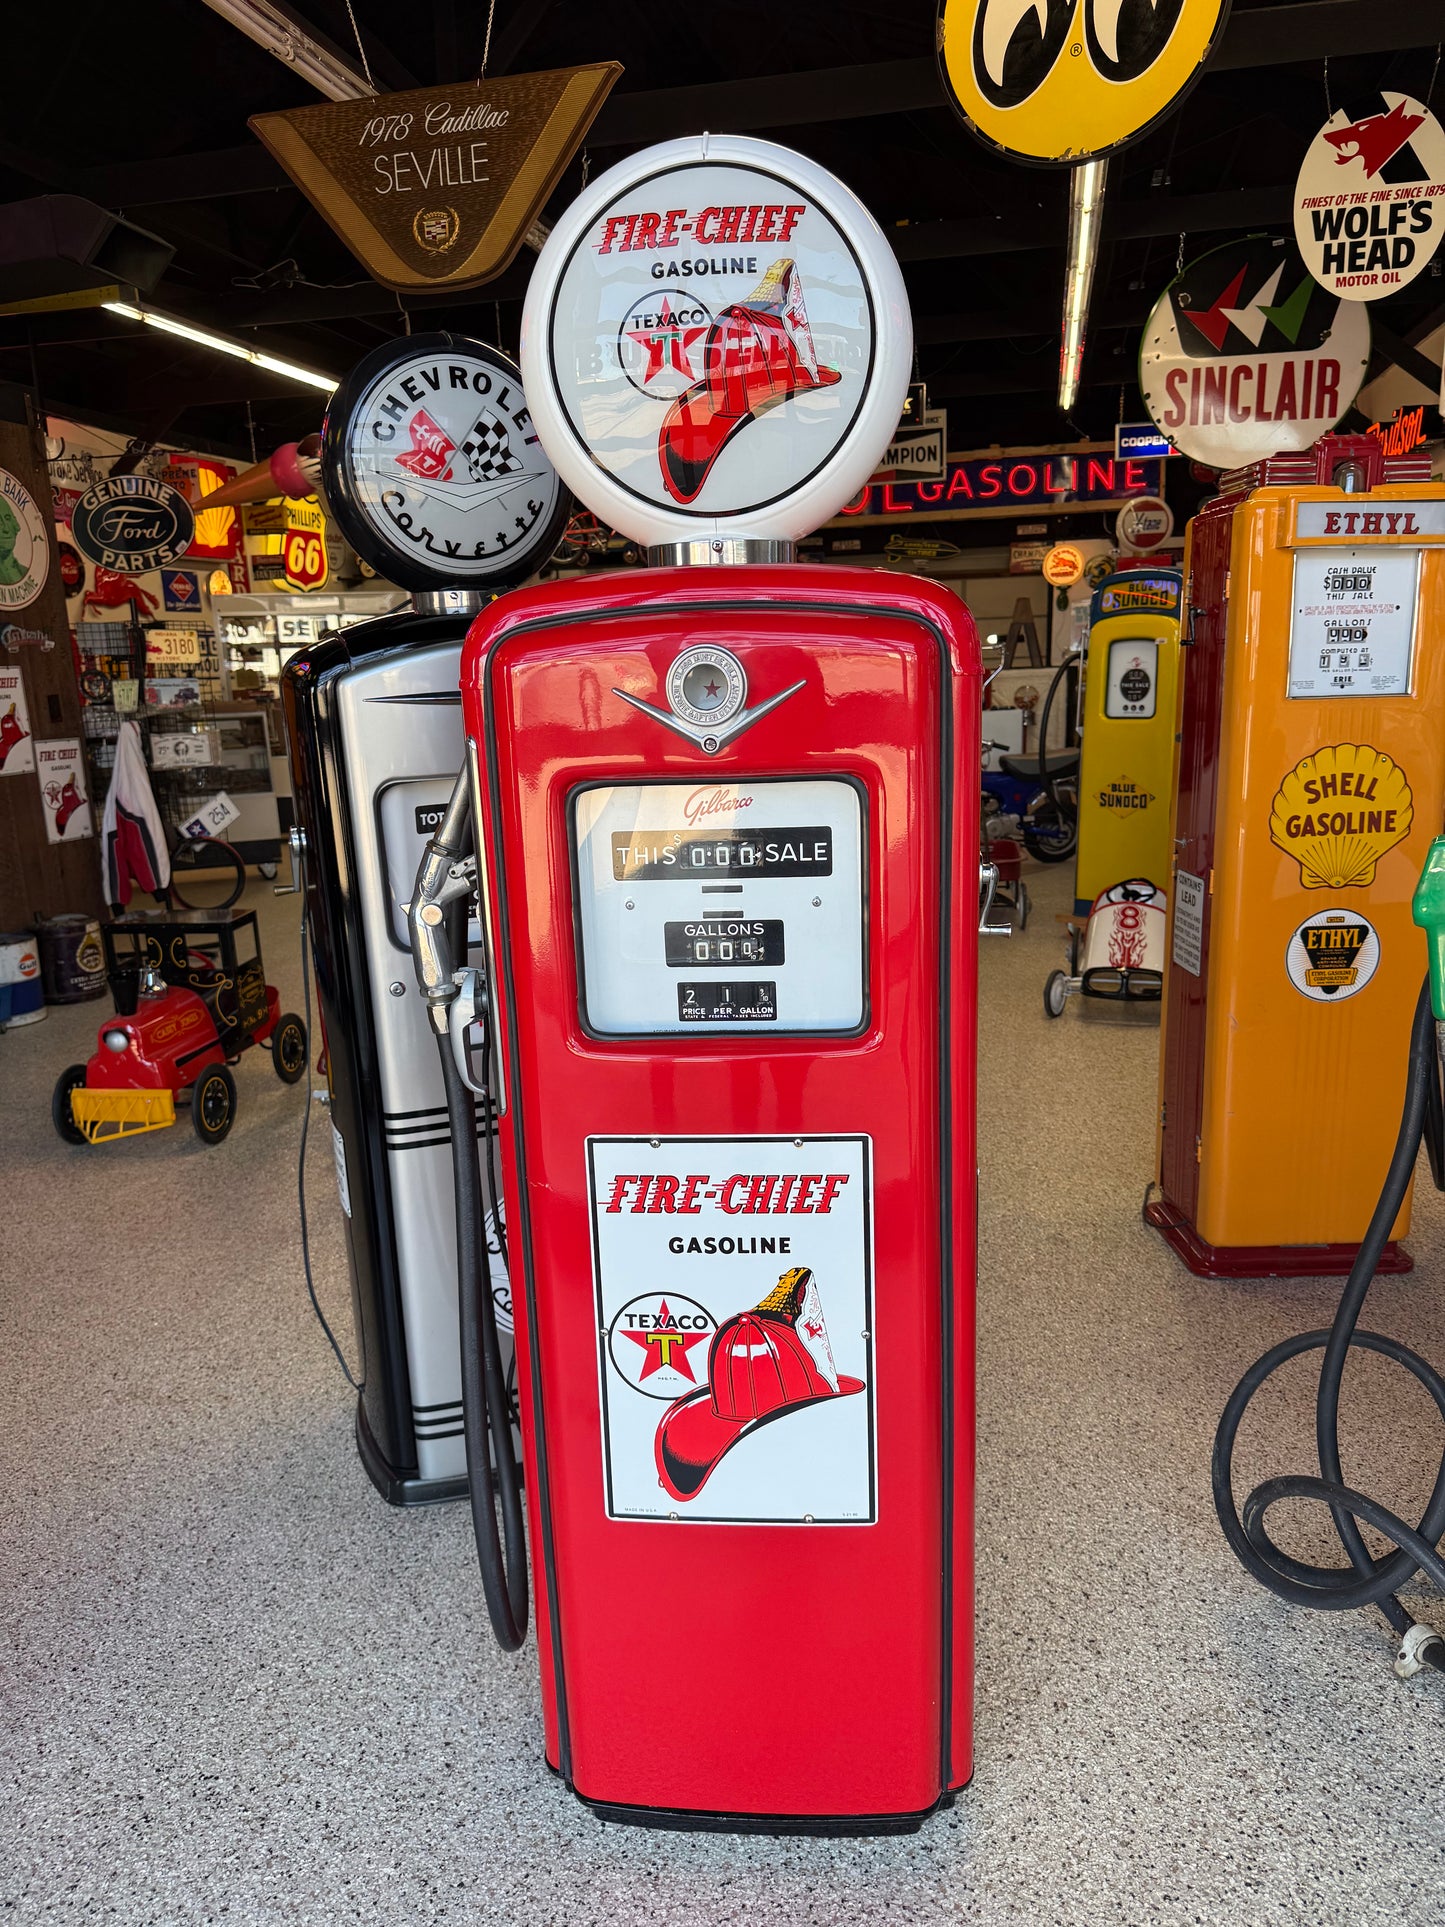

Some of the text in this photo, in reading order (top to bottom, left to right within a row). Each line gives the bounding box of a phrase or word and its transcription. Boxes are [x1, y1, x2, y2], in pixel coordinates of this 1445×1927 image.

[359, 102, 509, 147] 1978 Cadillac
[374, 142, 490, 195] SEVILLE
[1301, 184, 1445, 209] FINEST OF THE FINE SINCE 1879
[592, 205, 807, 255] FIRE-CHIEF
[1311, 199, 1433, 242] WOLF'S
[1322, 237, 1415, 275] HEAD
[651, 257, 758, 279] GASOLINE
[1335, 271, 1401, 288] MOTOR OIL
[631, 309, 705, 330] TEXACO
[1164, 359, 1341, 428] SINCLAIR
[917, 459, 1148, 502] GASOLINE
[3, 476, 31, 512] BANK
[83, 478, 174, 510] GENUINE
[96, 505, 167, 544] Ford
[381, 490, 545, 560] Corvette
[1323, 512, 1420, 535] ETHYL
[101, 545, 173, 571] PARTS
[288, 535, 321, 576] 66
[1327, 566, 1348, 575] CASH
[1129, 583, 1154, 593] BLUE
[1326, 592, 1374, 601] THIS SALE
[1112, 590, 1168, 609] SUNOCO
[1323, 619, 1372, 628] GALLONS
[164, 638, 195, 655] 3180
[0, 677, 19, 689] HIEF
[1333, 675, 1353, 683] ERIE
[39, 748, 78, 762] FIRE CHIEF
[1111, 783, 1137, 793] BLUE
[1303, 772, 1379, 804] SHELL
[683, 785, 754, 826] Gilbarco
[1099, 792, 1148, 809] SUNOCO
[208, 803, 231, 826] 254
[1285, 810, 1398, 839] GASOLINE
[616, 846, 676, 866] THIS
[765, 842, 828, 863] SALE
[1179, 874, 1202, 893] CONTAINS
[1181, 889, 1196, 907] LEAD
[684, 922, 765, 936] GALLONS
[1119, 905, 1139, 932] 8
[1306, 928, 1363, 950] ETHYL
[19, 960, 37, 970] Gulf
[686, 989, 696, 1003] 2
[682, 1006, 774, 1015] PRICE PER GALLON
[598, 1173, 850, 1216] FIRE-CHIEF
[668, 1236, 791, 1255] GASOLINE
[624, 1313, 709, 1330] TEXACO
